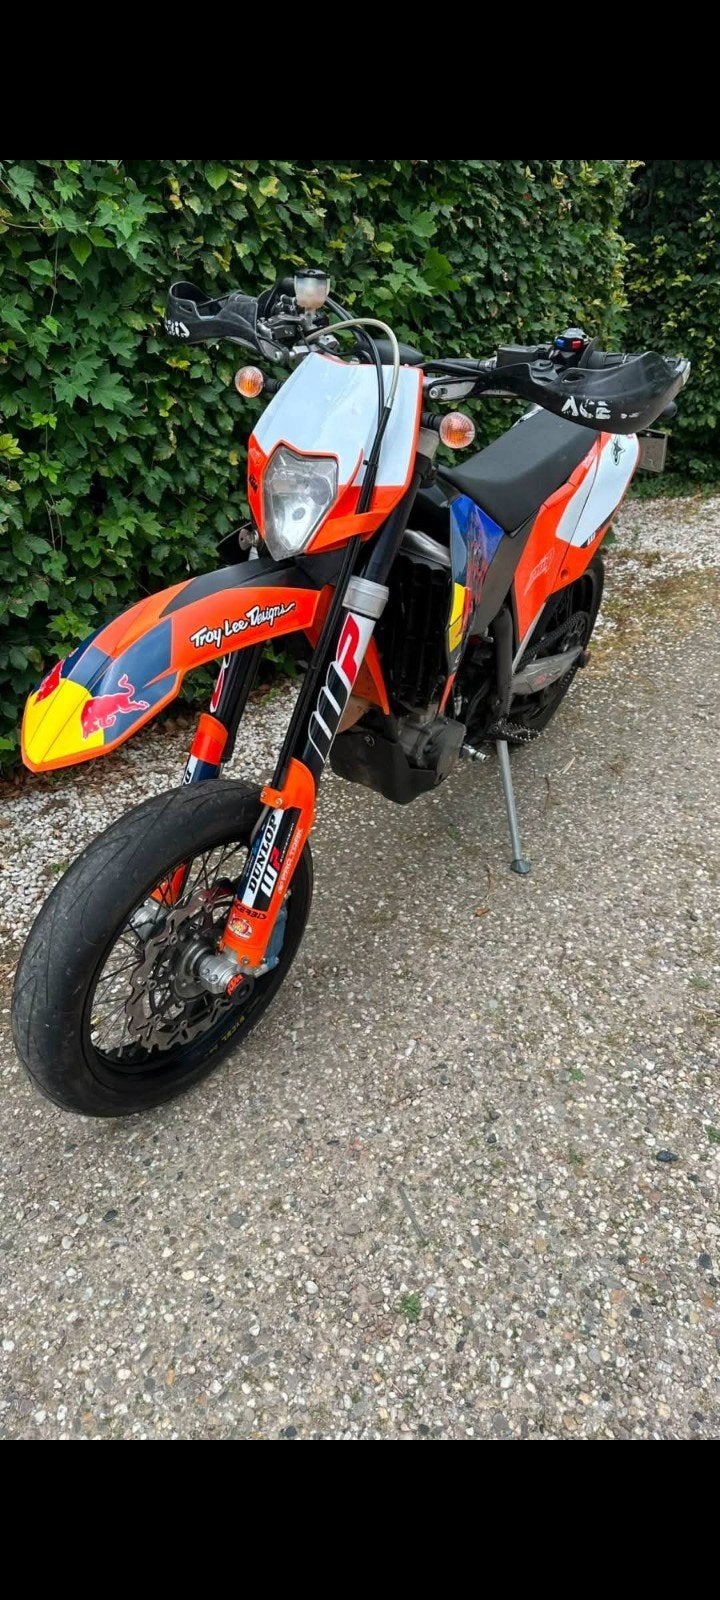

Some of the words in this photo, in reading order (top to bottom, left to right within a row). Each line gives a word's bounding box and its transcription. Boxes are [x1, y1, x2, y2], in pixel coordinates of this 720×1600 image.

[190, 626, 222, 649] Troy
[224, 619, 249, 637] Lee
[245, 602, 296, 627] Designs
[249, 814, 277, 893] DUNLOP
